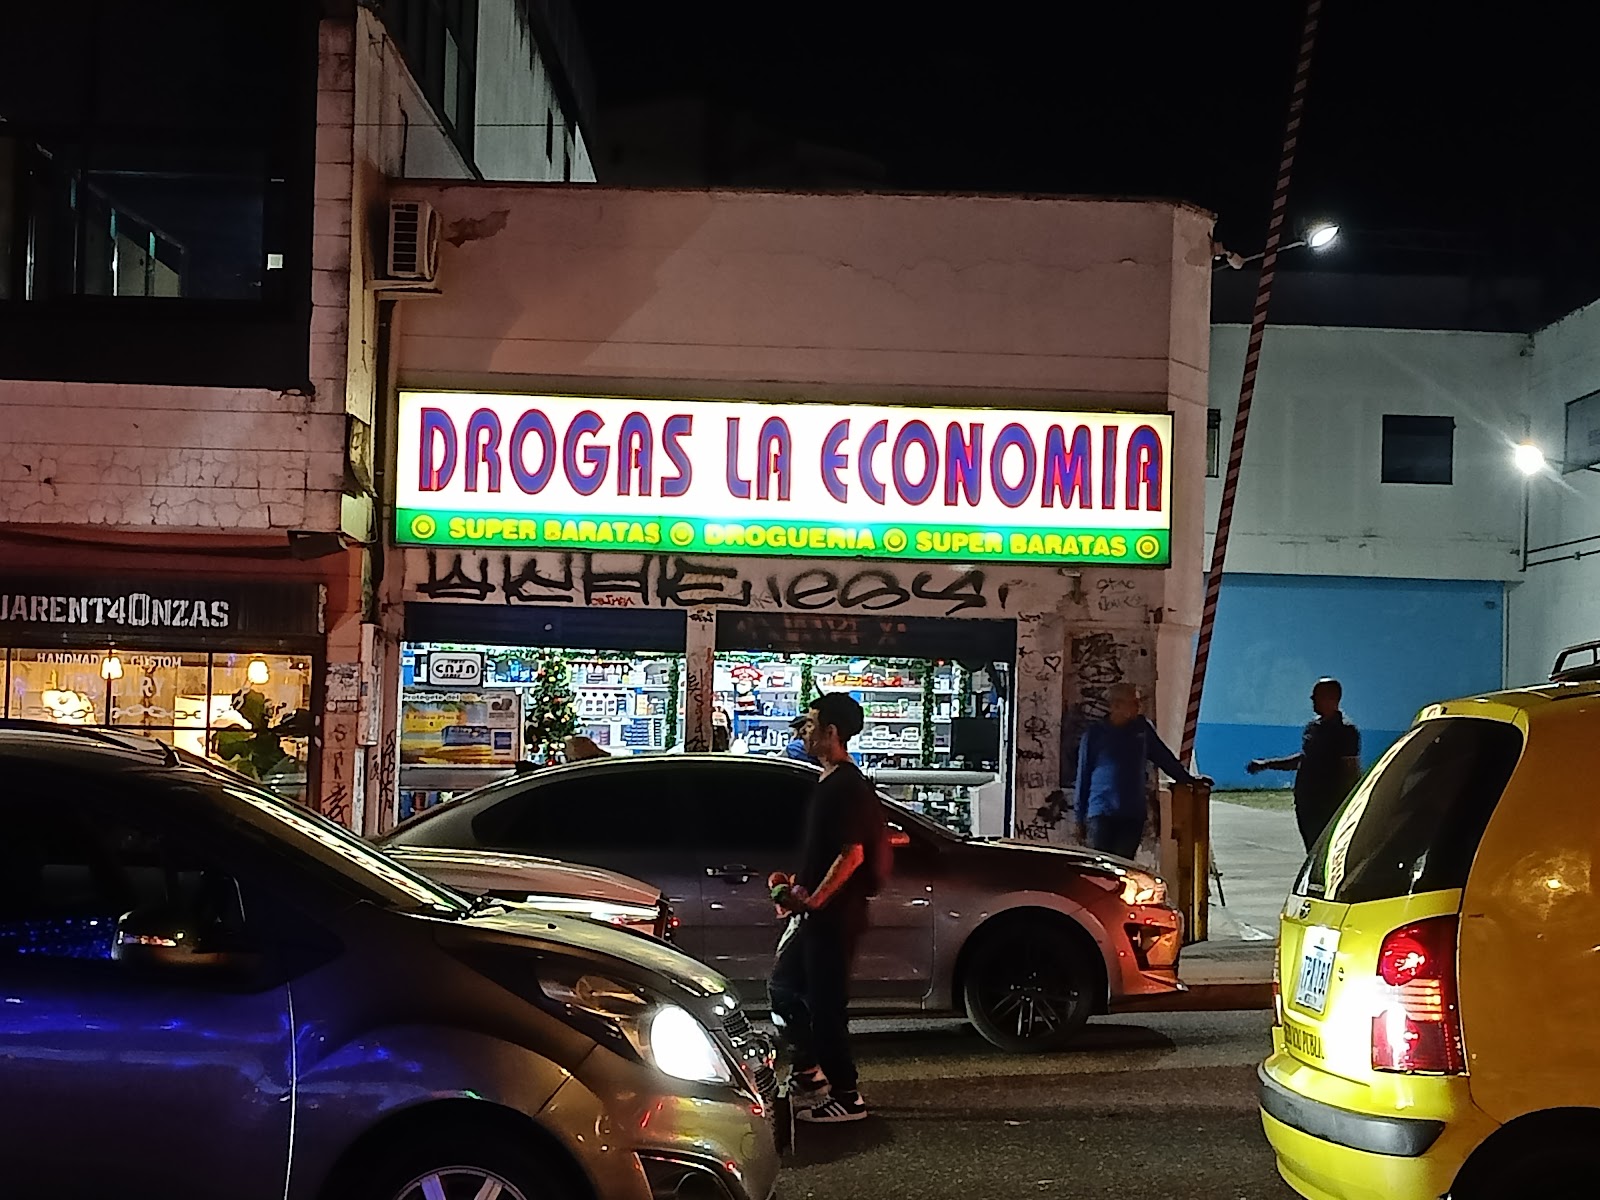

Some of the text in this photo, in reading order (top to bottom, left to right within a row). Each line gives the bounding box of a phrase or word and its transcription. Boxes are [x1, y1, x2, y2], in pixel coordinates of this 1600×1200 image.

[418, 407, 1163, 512] DROGAS LA ECONOMIA
[448, 517, 662, 545] SUPER BARATAS
[703, 523, 876, 551] DROGUERIA
[914, 530, 1128, 557] SUPER BARATAS
[37, 652, 100, 665] HANDMAD
[130, 655, 183, 668] CUSTOM
